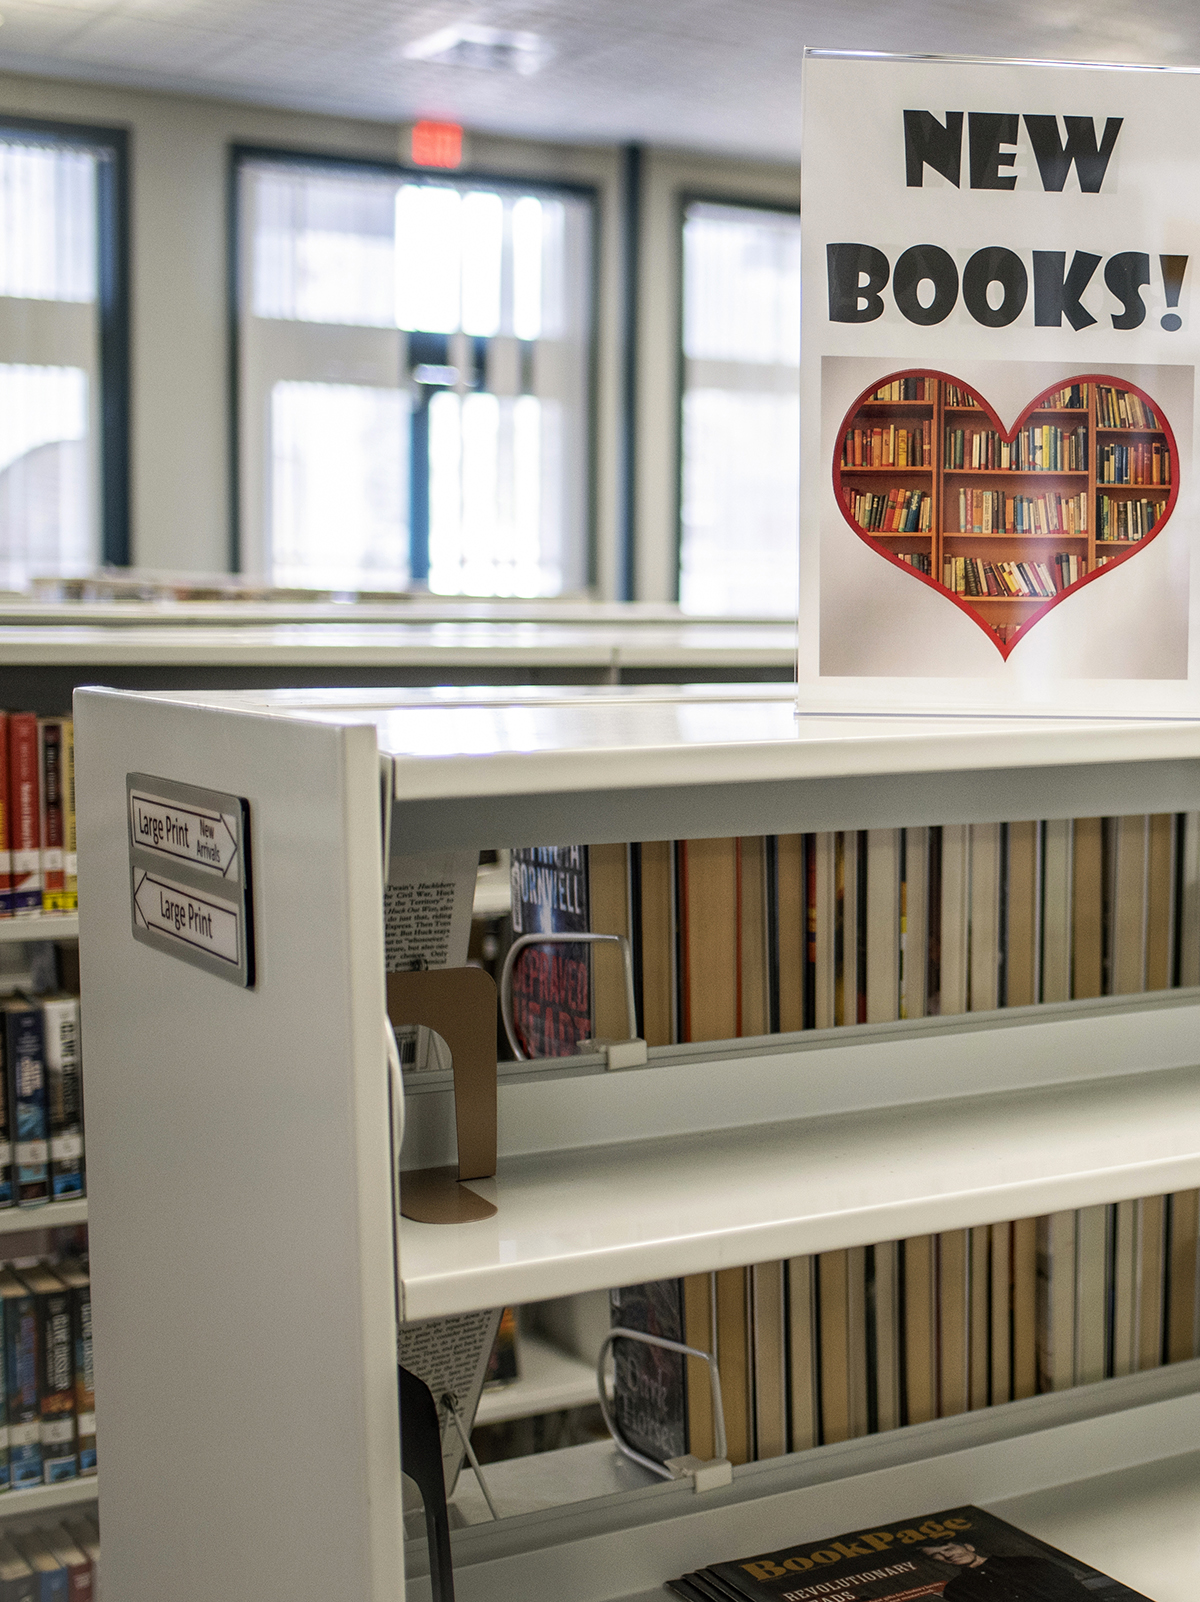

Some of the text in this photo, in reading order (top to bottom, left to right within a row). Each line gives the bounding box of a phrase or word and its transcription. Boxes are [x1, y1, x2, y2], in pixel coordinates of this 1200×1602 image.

[903, 109, 1124, 194] NEW
[826, 242, 1190, 332] BOOKS!
[138, 807, 190, 849] Large Print
[200, 819, 215, 840] New
[196, 839, 221, 863] Arrivals
[396, 891, 413, 899] Civil
[514, 862, 581, 915] ORNWELL
[159, 890, 213, 939] Large Print
[740, 1518, 973, 1582] BookPage
[783, 1561, 918, 1602] REVOLUTIONARY
